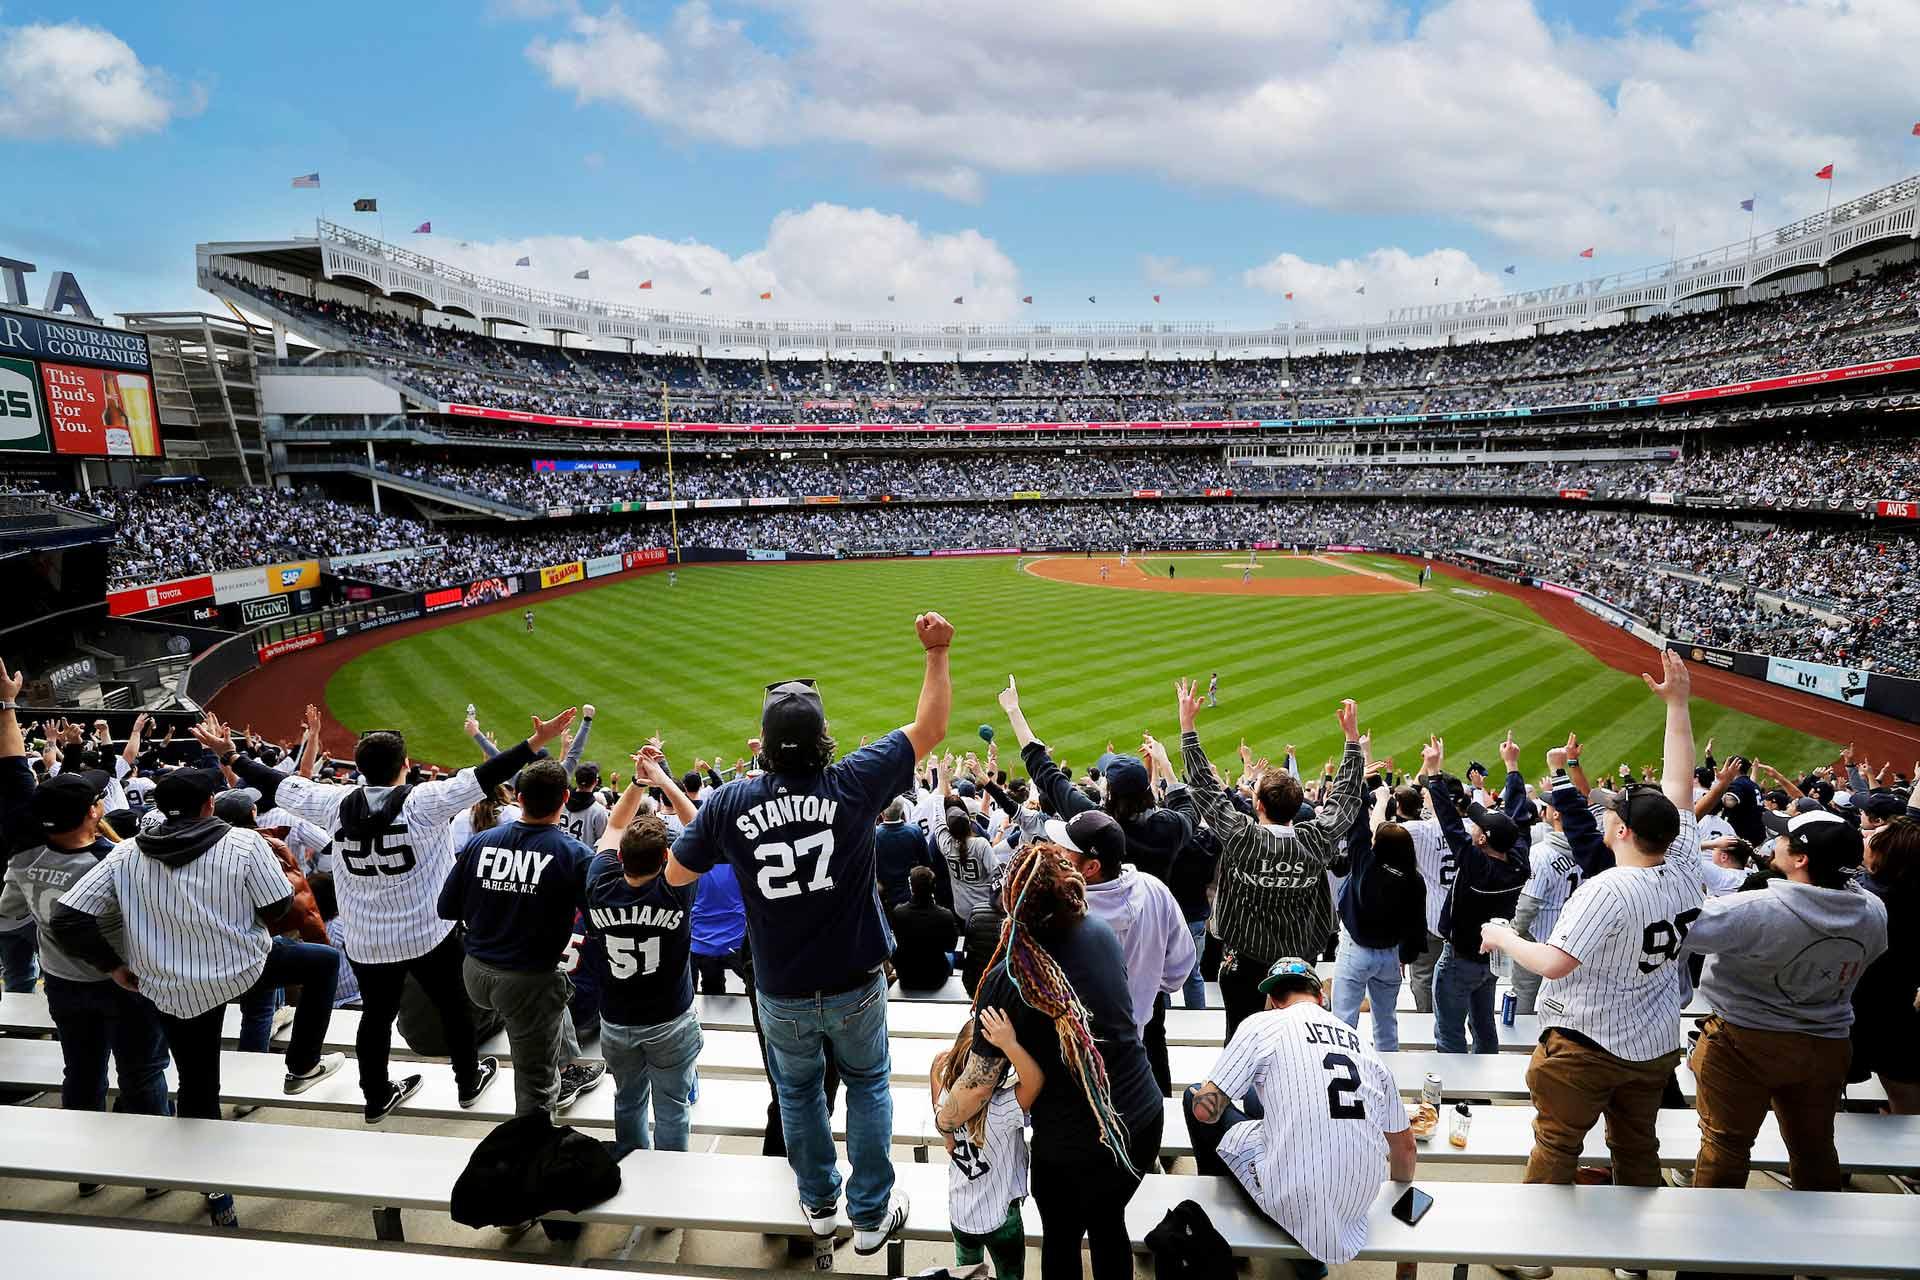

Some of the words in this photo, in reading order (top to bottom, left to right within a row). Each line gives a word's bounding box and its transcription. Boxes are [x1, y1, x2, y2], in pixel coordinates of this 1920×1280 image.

[43, 323, 146, 352] INSURANCE
[47, 340, 148, 366] COMPANIES
[46, 368, 85, 386] This
[49, 384, 96, 402] Bud's
[53, 401, 81, 417] For
[55, 416, 92, 433] You.
[1886, 502, 1908, 516] AVIS
[281, 570, 300, 583] SAP
[159, 589, 182, 600] TOYOTA
[194, 608, 219, 620] FedEx
[560, 814, 583, 840] 24
[736, 795, 838, 840] STANTON
[334, 823, 417, 877] 25
[476, 846, 554, 885] FDNY
[754, 829, 836, 900] 27
[1260, 859, 1304, 874] LOS
[590, 905, 684, 930] WILLIAMS
[605, 934, 660, 979] 51
[1305, 1021, 1361, 1054] JETER
[1323, 1052, 1366, 1120] 2
